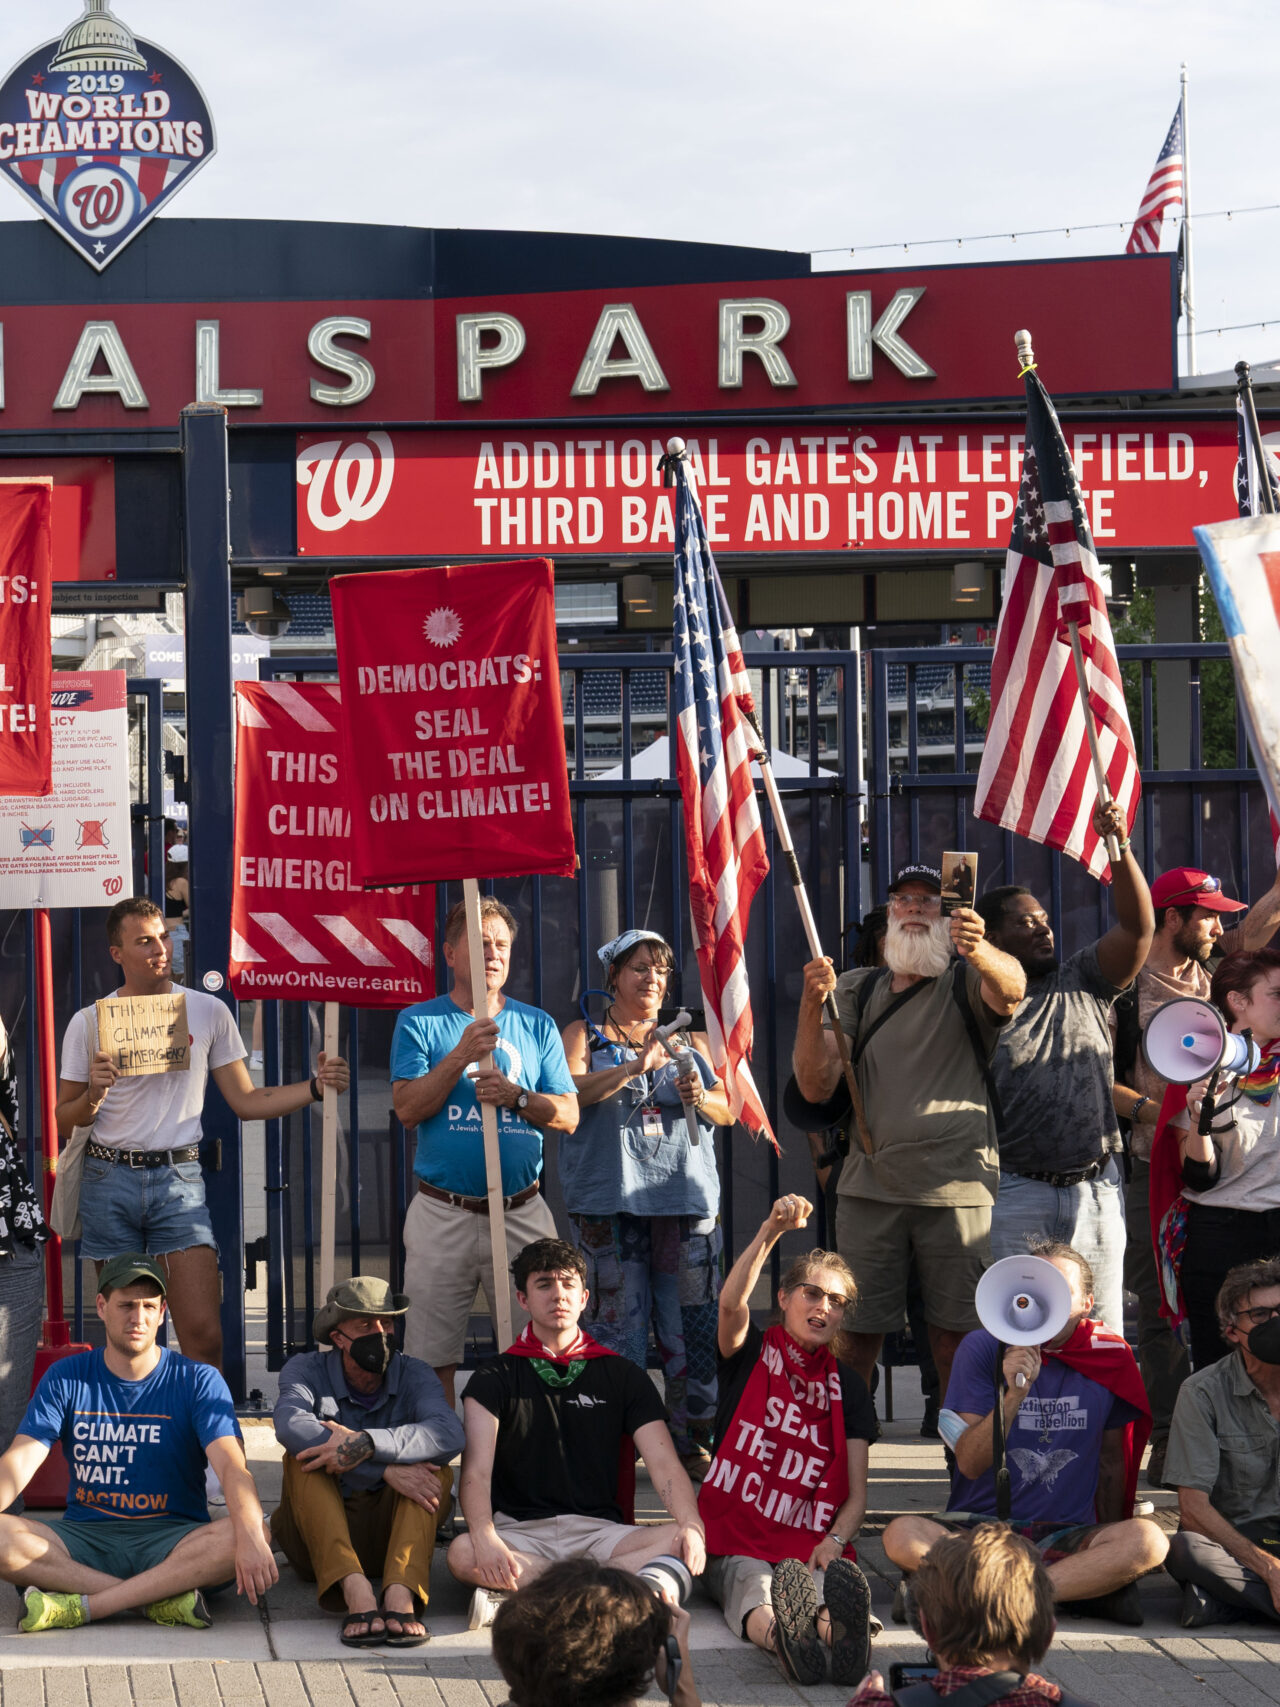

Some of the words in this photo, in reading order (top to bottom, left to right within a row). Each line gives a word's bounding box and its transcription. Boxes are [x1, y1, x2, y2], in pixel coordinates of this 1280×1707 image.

[66, 74, 125, 93] 2019
[25, 89, 170, 120] WORLD
[72, 178, 124, 231] W
[455, 286, 937, 401] PARK
[745, 436, 877, 485] GATES
[892, 435, 943, 484] AT
[958, 434, 1025, 482] LEF
[1073, 432, 1208, 488] FIELD,
[296, 431, 395, 532] W
[474, 496, 604, 546] THIRD
[622, 494, 730, 544] BAE
[744, 493, 830, 542] AND
[848, 491, 971, 540] HOME
[83, 593, 92, 601] to
[94, 592, 139, 602] inspection
[149, 651, 183, 663] COME
[357, 653, 542, 695] DEMOCRATS:
[414, 707, 489, 740] SEAL
[267, 751, 338, 784] THIS
[387, 750, 442, 781] THE
[448, 744, 525, 778] DEAL
[370, 792, 409, 823] ON
[417, 782, 551, 820] CLIMATE!
[268, 804, 351, 838] CLIM
[240, 968, 423, 994] NowOrNever.earth
[107, 1003, 145, 1018] THIS
[113, 1023, 176, 1043] CLIMATE
[118, 1046, 187, 1069] EMERGENCY
[456, 1124, 479, 1132] Jewish
[503, 1127, 525, 1135] Climate
[73, 1421, 161, 1444] CLIMATE
[1034, 1412, 1085, 1429] rebellion
[73, 1443, 137, 1464] CAN'T
[735, 1419, 778, 1472] THE
[73, 1463, 129, 1485] WAIT.
[75, 1486, 168, 1510] #ACTNOW
